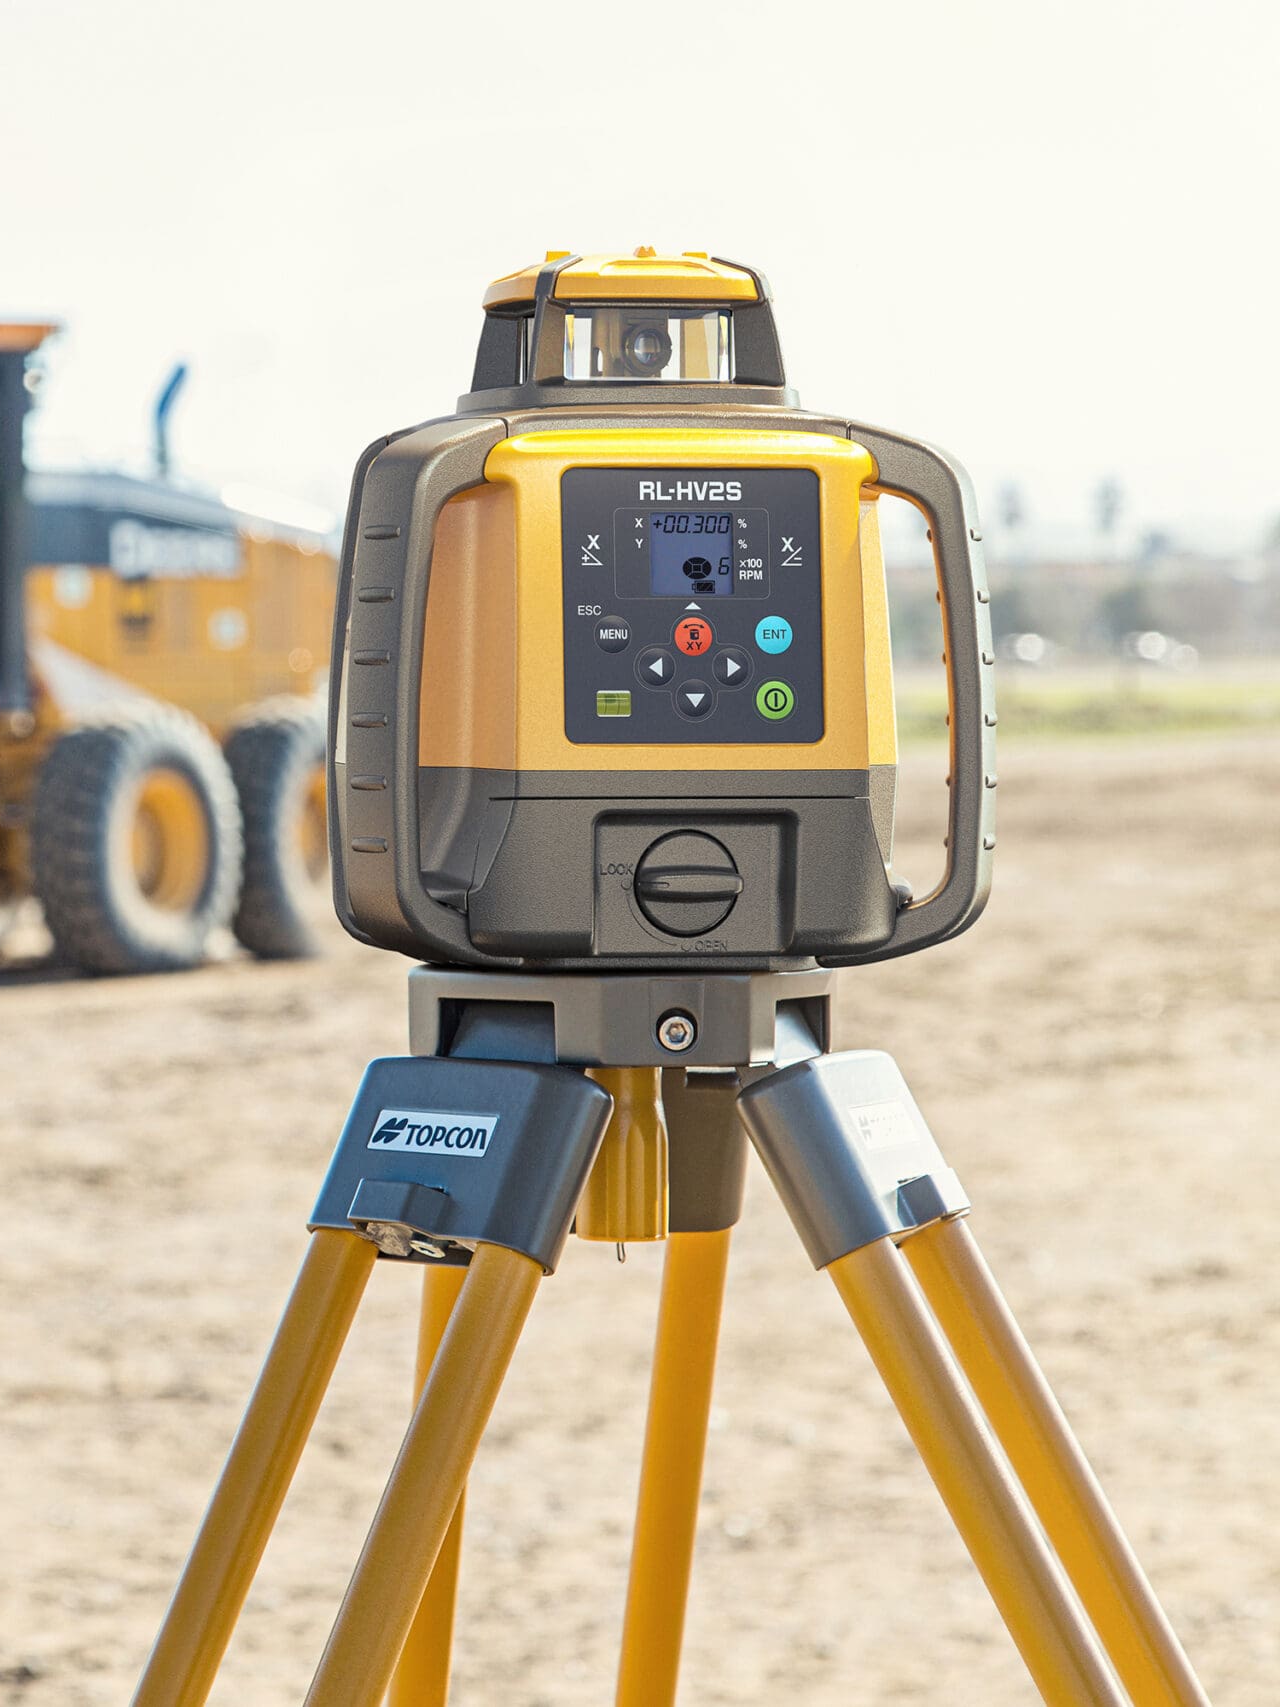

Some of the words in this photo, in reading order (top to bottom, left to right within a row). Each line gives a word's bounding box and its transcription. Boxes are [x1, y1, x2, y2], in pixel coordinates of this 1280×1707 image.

[639, 481, 742, 501] RL-HV2S
[635, 518, 643, 528] X
[653, 515, 730, 534] +00.300
[737, 519, 747, 529] %
[587, 535, 600, 550] X
[635, 538, 644, 549] Y
[738, 539, 748, 550] %
[781, 537, 793, 552] X
[718, 557, 730, 576] 6
[739, 570, 763, 580] RPM
[577, 605, 602, 616] ESC
[600, 629, 628, 640] MENU
[763, 629, 787, 640] ENT
